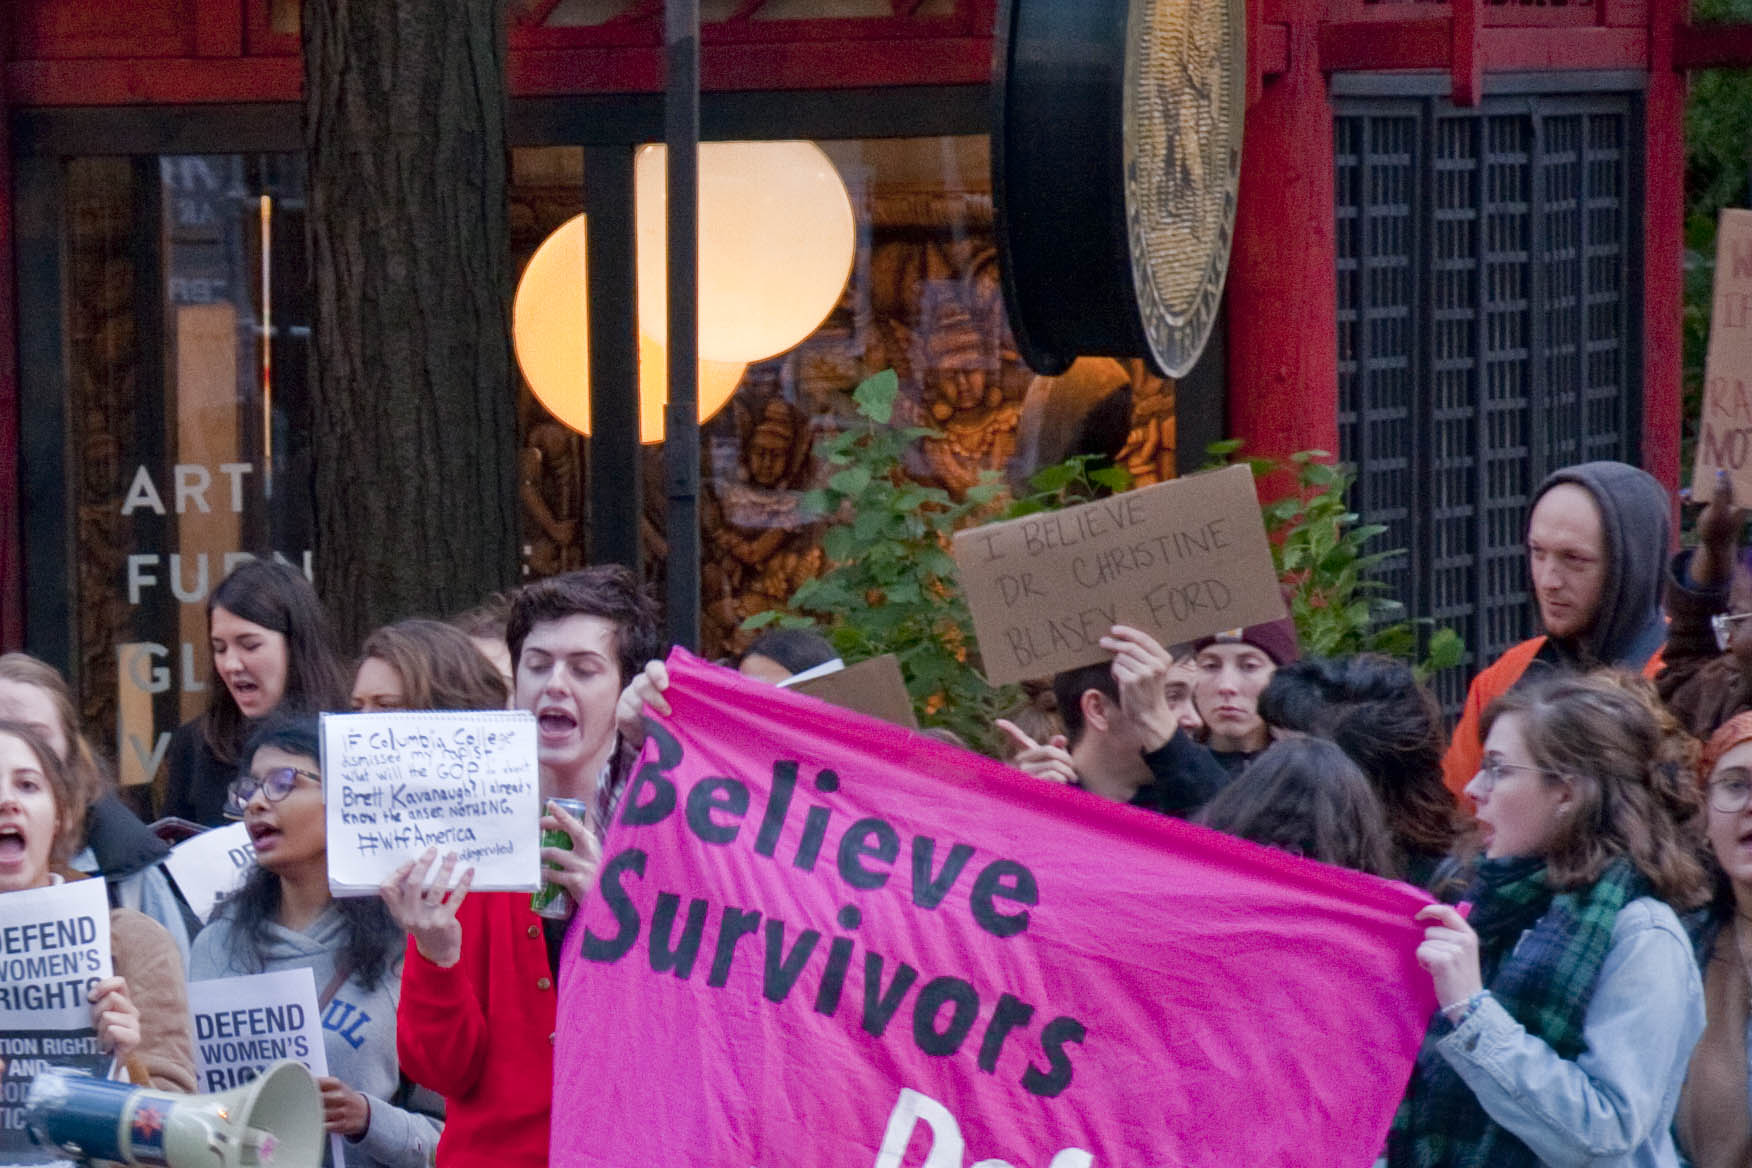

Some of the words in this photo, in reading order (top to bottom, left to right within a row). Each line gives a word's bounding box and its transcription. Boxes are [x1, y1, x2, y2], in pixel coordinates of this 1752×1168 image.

[121, 462, 252, 515] ART
[979, 533, 1005, 562] I
[1021, 495, 1146, 557] BELIEVE
[997, 572, 1045, 608] DR
[1073, 517, 1232, 589] CHRISTINE
[1144, 579, 1232, 628] FORD
[620, 725, 1040, 938] Believe
[580, 848, 1087, 1099] Survivors
[42, 1036, 102, 1056] RIGHT
[196, 1003, 305, 1041] DEFEND
[8, 1058, 47, 1077] AND
[200, 1035, 310, 1065] WOMEN'S
